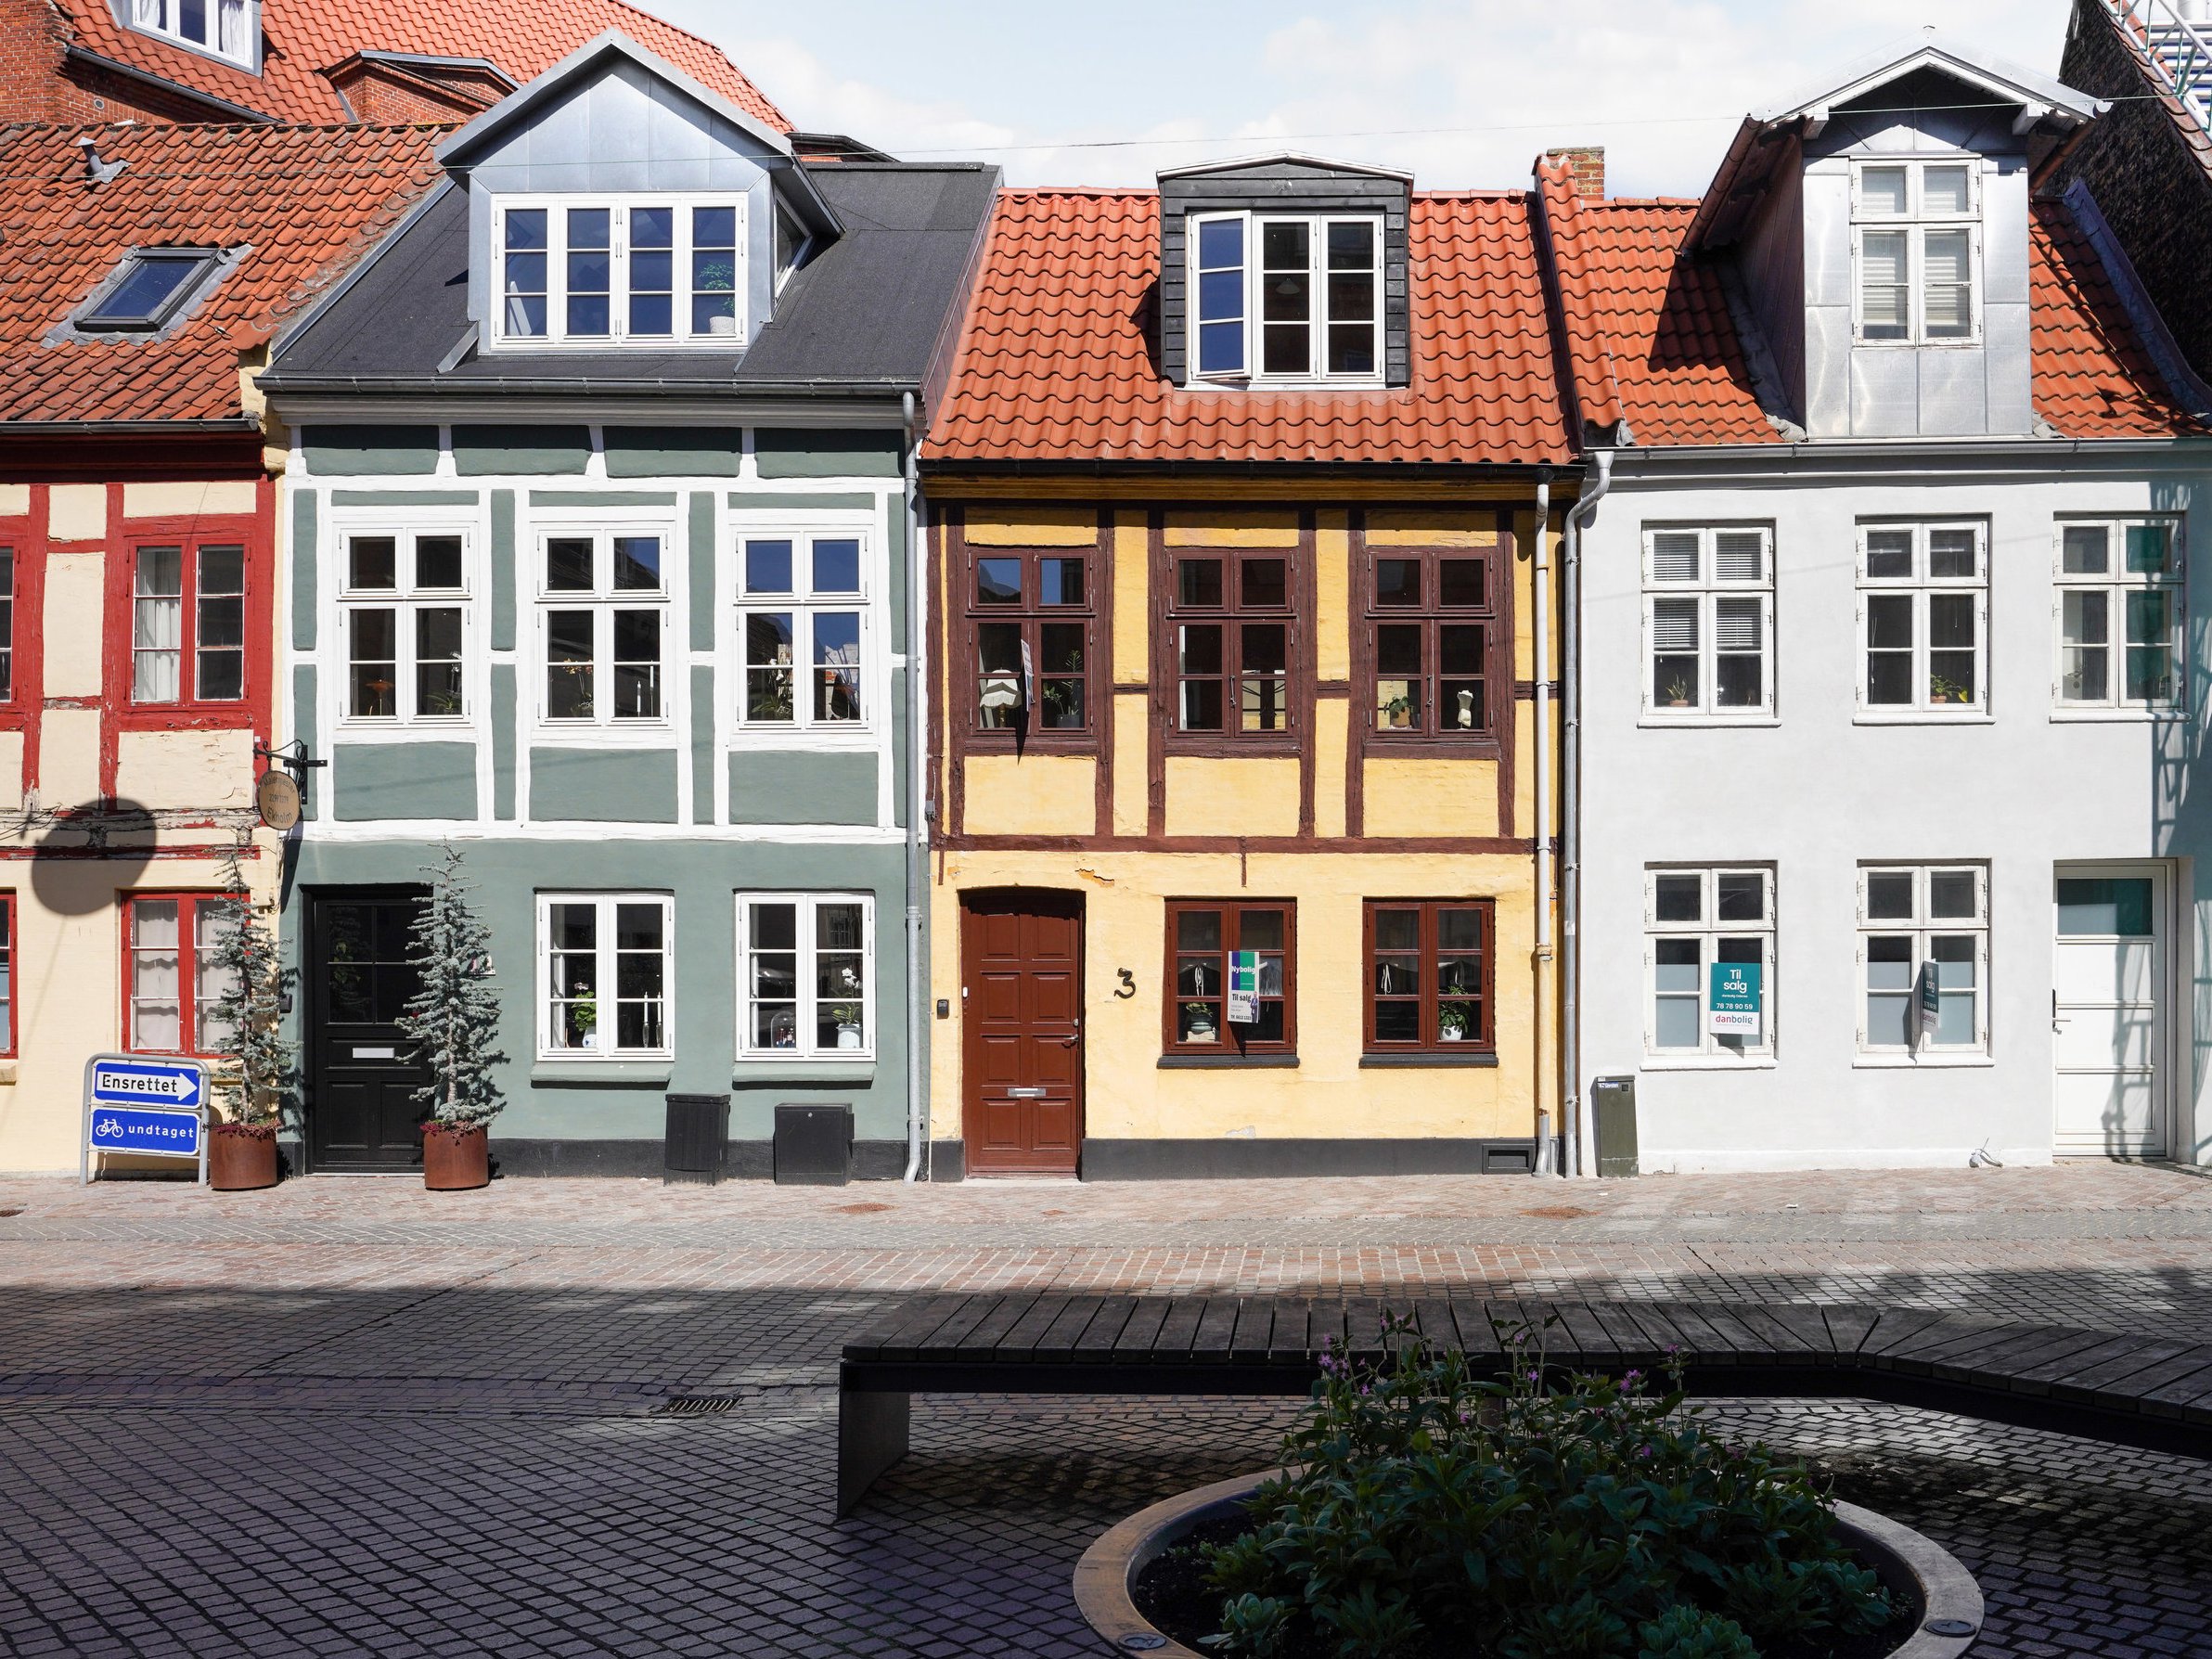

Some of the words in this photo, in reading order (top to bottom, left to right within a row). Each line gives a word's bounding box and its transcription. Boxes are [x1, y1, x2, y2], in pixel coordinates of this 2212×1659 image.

[1231, 965, 1255, 974] Nybolig
[1730, 969, 1742, 980] Til
[1113, 967, 1136, 999] 3
[1723, 980, 1747, 994] salg
[1240, 994, 1252, 1003] salg
[1716, 1014, 1753, 1024] danbolig
[102, 1074, 177, 1093] Ensrettet
[128, 1125, 194, 1138] undtaget
